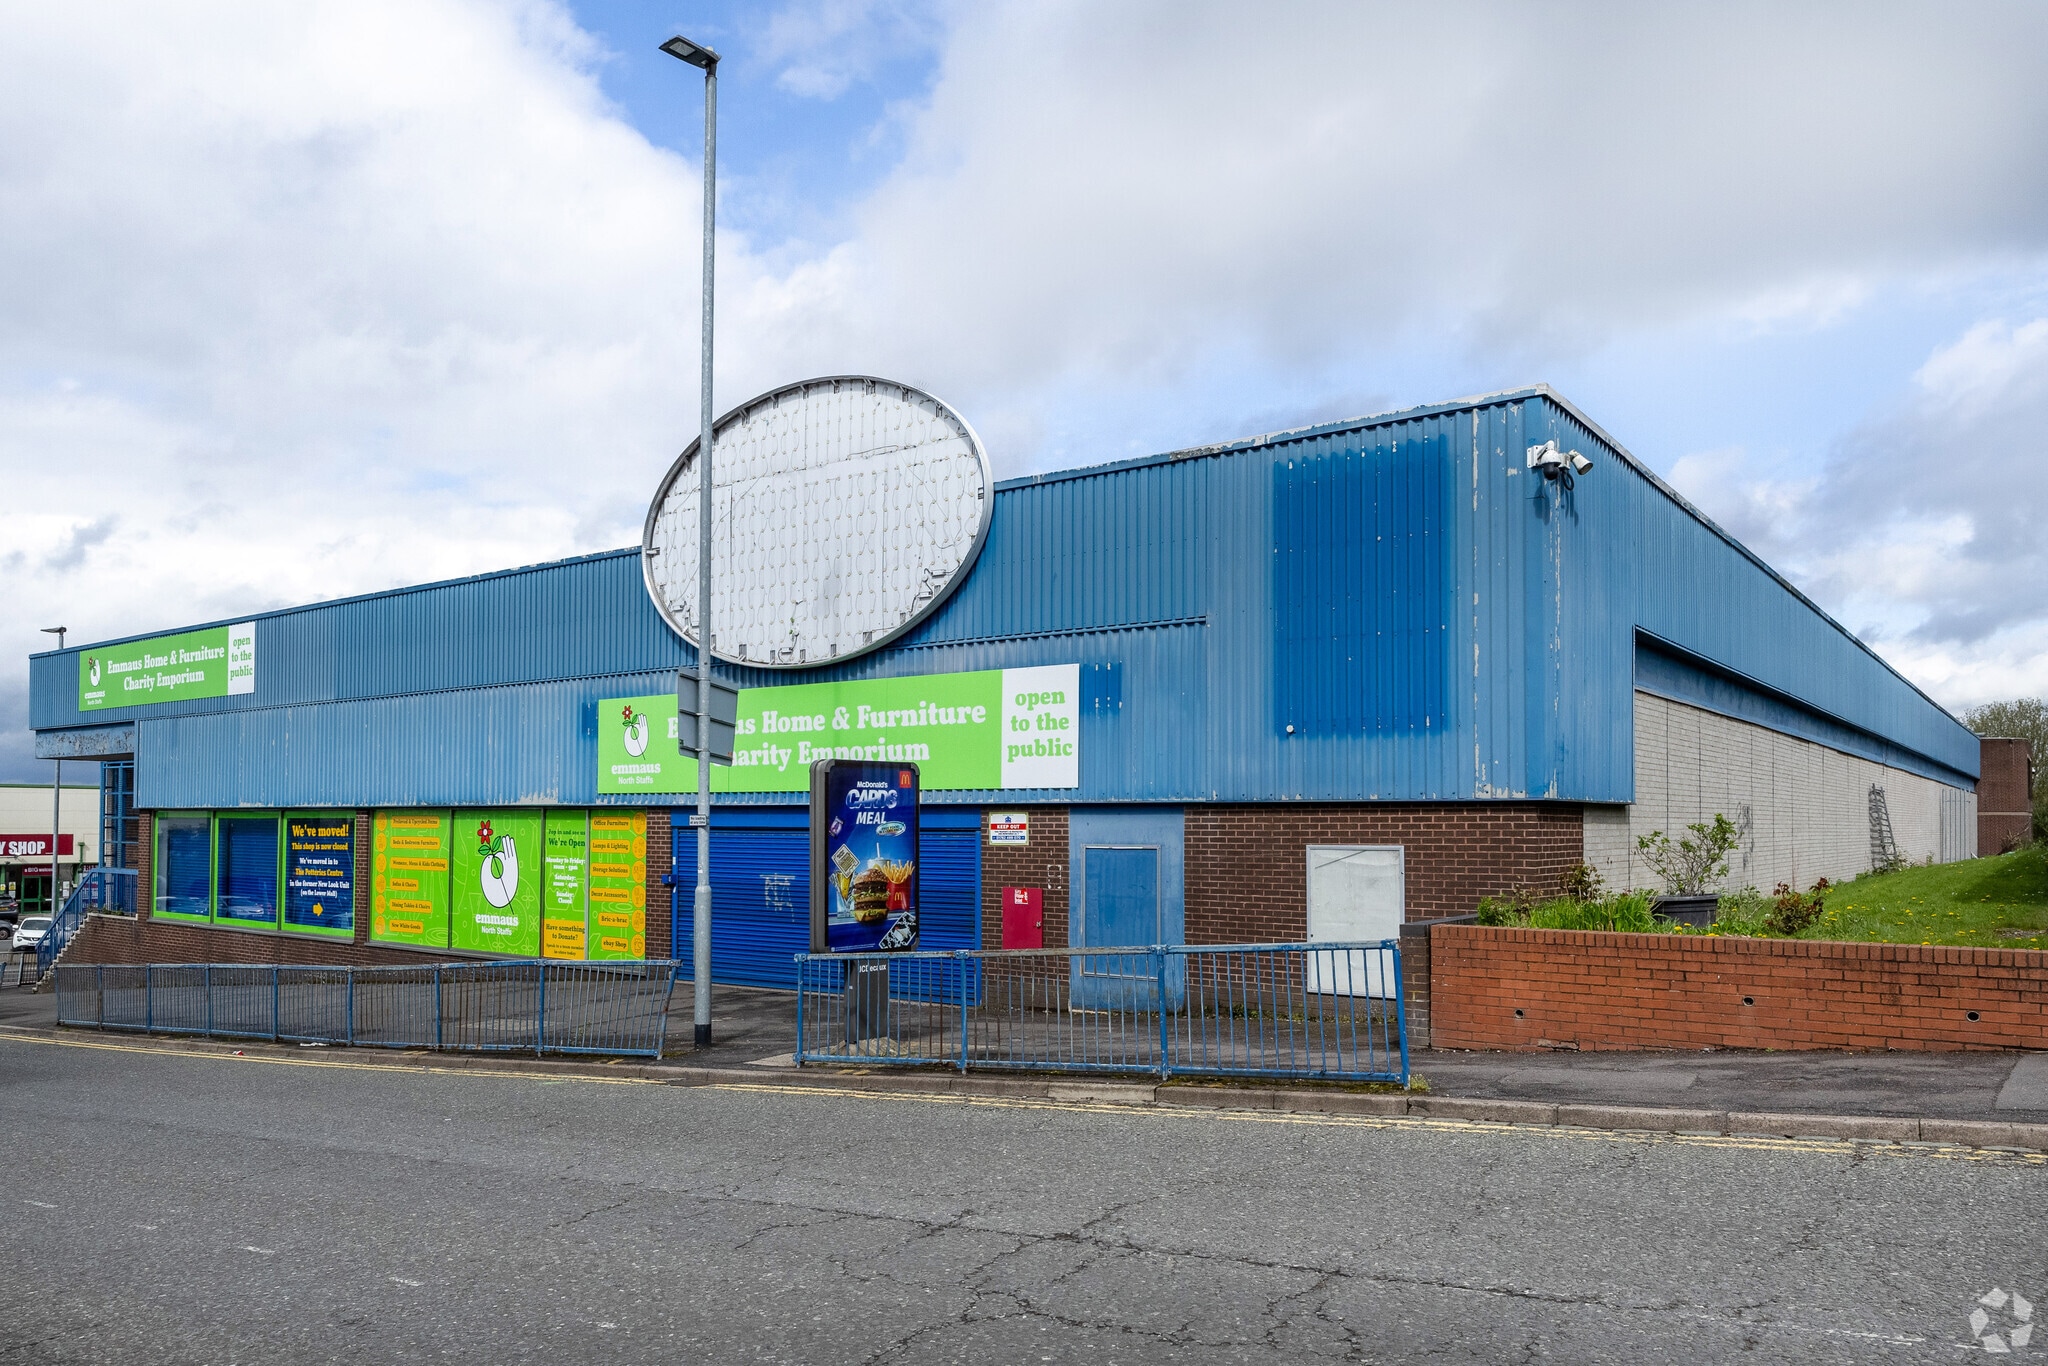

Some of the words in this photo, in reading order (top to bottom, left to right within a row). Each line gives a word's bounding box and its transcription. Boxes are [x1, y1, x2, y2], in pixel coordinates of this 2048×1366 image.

[233, 637, 250, 649] open
[108, 659, 142, 674] Emmaus
[144, 654, 168, 669] Home
[170, 651, 177, 665] &
[179, 646, 225, 663] Furniture
[232, 653, 238, 662] to
[240, 650, 252, 661] the
[230, 665, 252, 680] public
[124, 674, 155, 692] Charity
[157, 668, 204, 690] Emporium
[1015, 691, 1065, 711] open
[762, 710, 825, 733] Home
[832, 706, 849, 730] &
[857, 701, 986, 729] Furniture
[1010, 715, 1030, 732] to
[1036, 712, 1070, 730] the
[1007, 738, 1073, 763] public
[612, 763, 660, 774] emmaus
[639, 776, 654, 784] Staffs
[846, 789, 898, 809] CARDS
[856, 812, 886, 824] MEAL
[292, 824, 316, 837] We've
[318, 824, 349, 836] moved!
[9, 841, 45, 855] SHOP
[303, 843, 314, 851] shop
[316, 842, 320, 850] is
[333, 842, 348, 850] closed
[549, 838, 567, 846] We're
[569, 839, 585, 848] Open
[305, 868, 326, 876] Potteries
[476, 914, 518, 926] emmaus
[482, 926, 496, 934] North
[497, 927, 512, 935] Staffs
[559, 926, 585, 934] something
